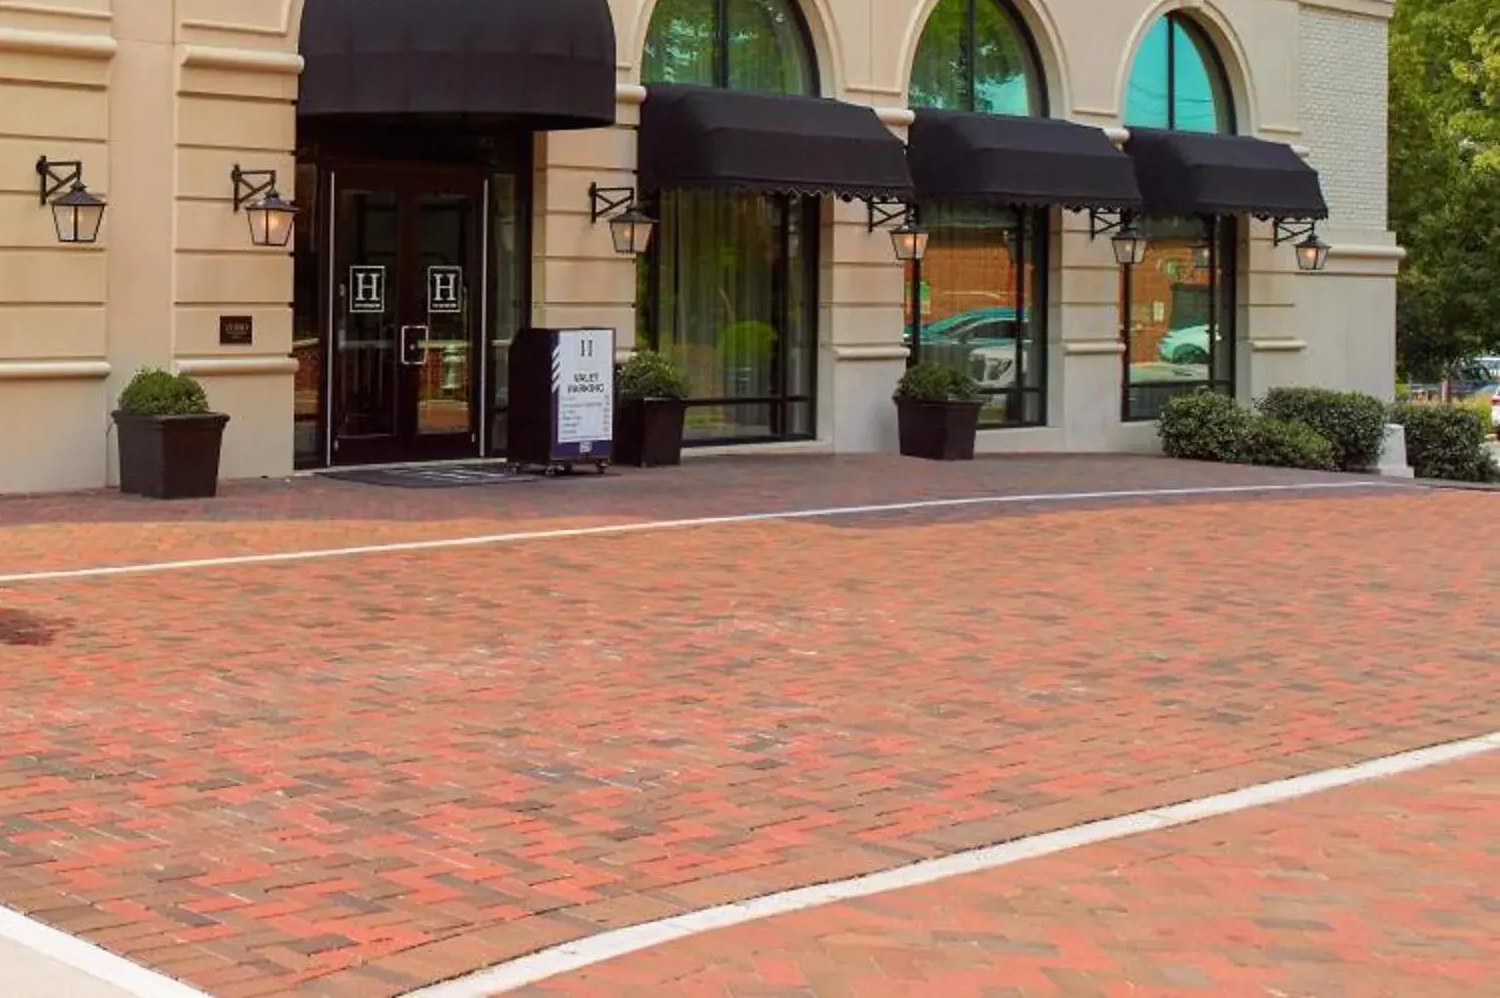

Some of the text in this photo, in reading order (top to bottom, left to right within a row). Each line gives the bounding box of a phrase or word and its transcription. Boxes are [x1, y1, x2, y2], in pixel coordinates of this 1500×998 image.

[356, 273, 380, 301] H
[433, 273, 457, 301] H
[567, 383, 604, 393] PARKING
